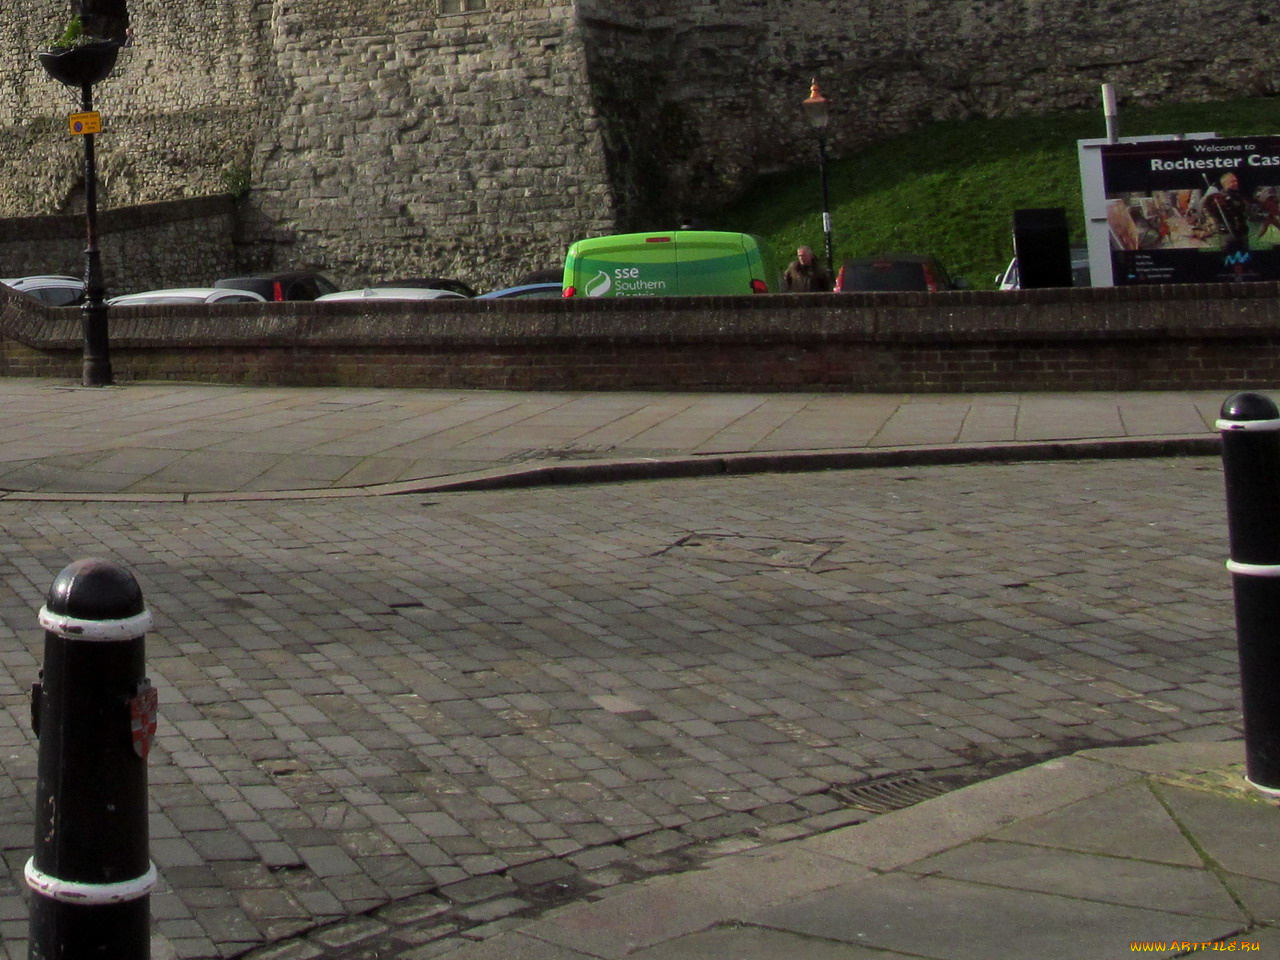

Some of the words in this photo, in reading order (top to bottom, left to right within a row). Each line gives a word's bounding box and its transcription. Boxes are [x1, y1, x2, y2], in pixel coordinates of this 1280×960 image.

[1151, 156, 1242, 171] Rochester
[1248, 154, 1280, 167] Cas
[615, 268, 639, 279] sse
[615, 280, 666, 291] Southern
